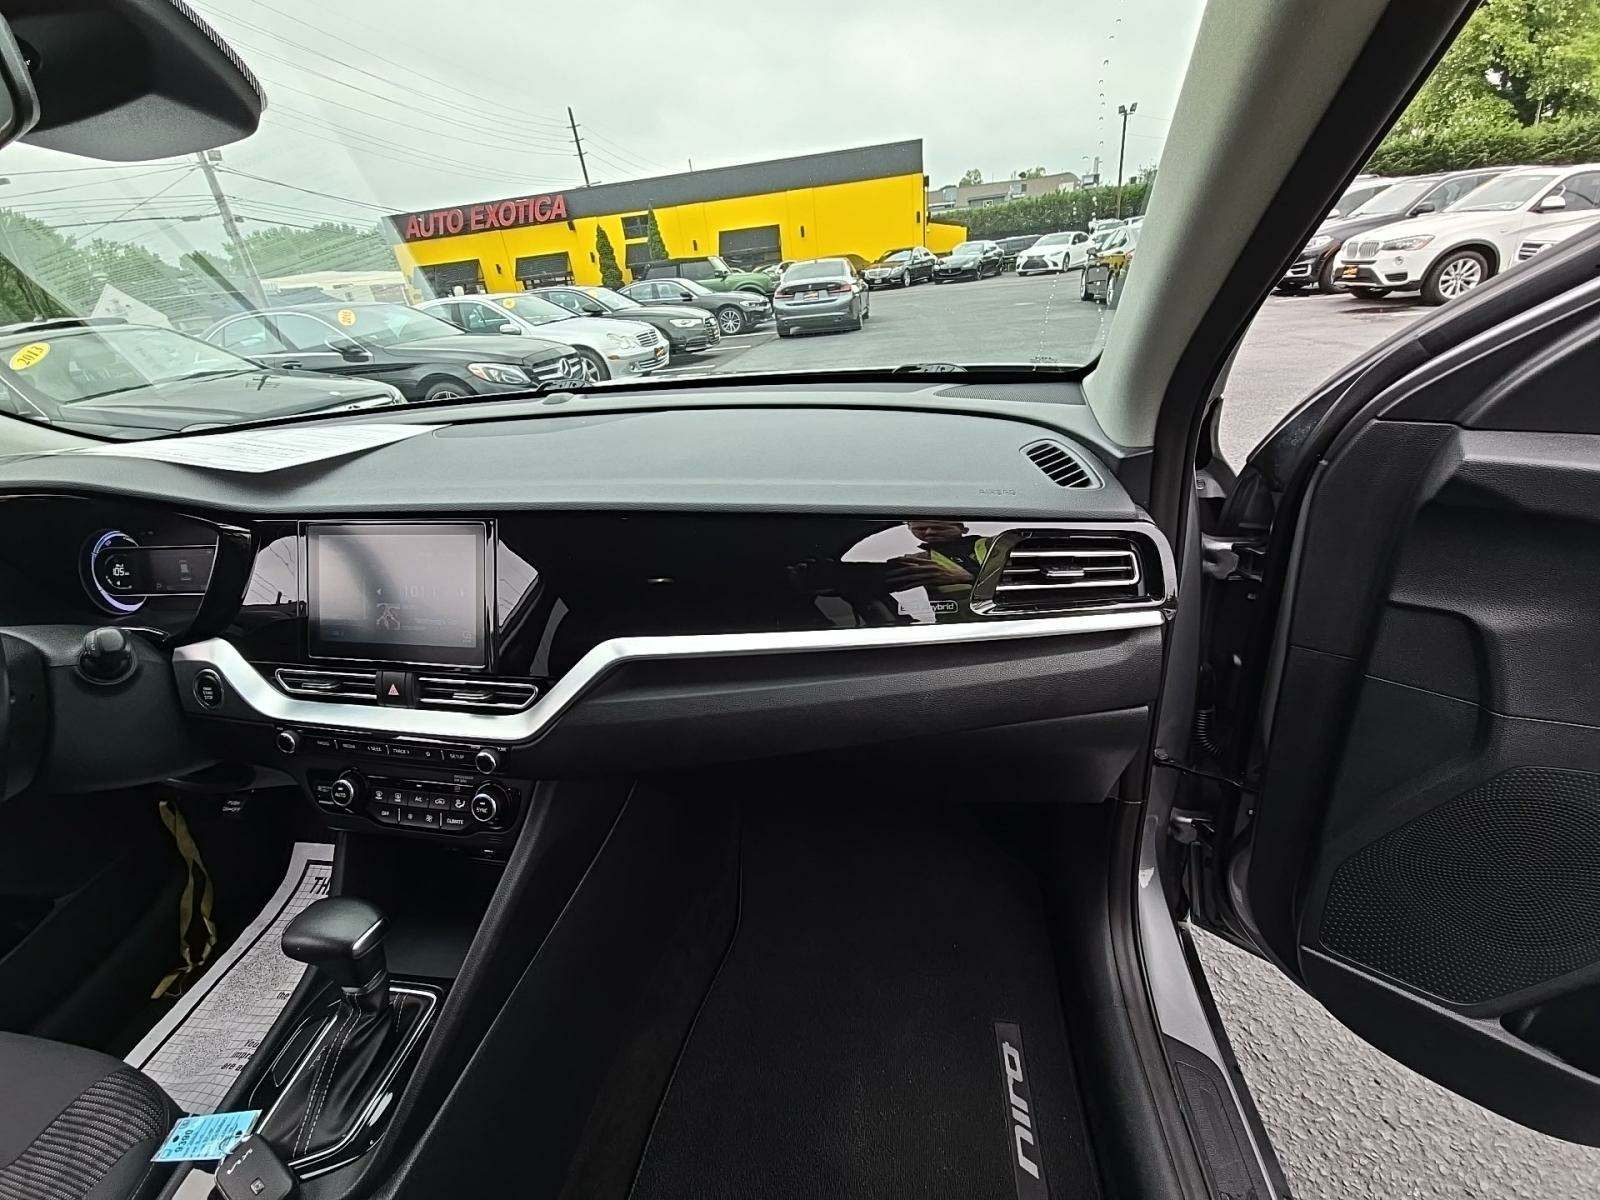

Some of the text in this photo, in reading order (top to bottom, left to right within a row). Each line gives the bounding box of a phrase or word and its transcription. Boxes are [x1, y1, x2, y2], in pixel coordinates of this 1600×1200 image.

[405, 194, 567, 239] AUTO EXOTICA
[931, 603, 954, 611] ybrid
